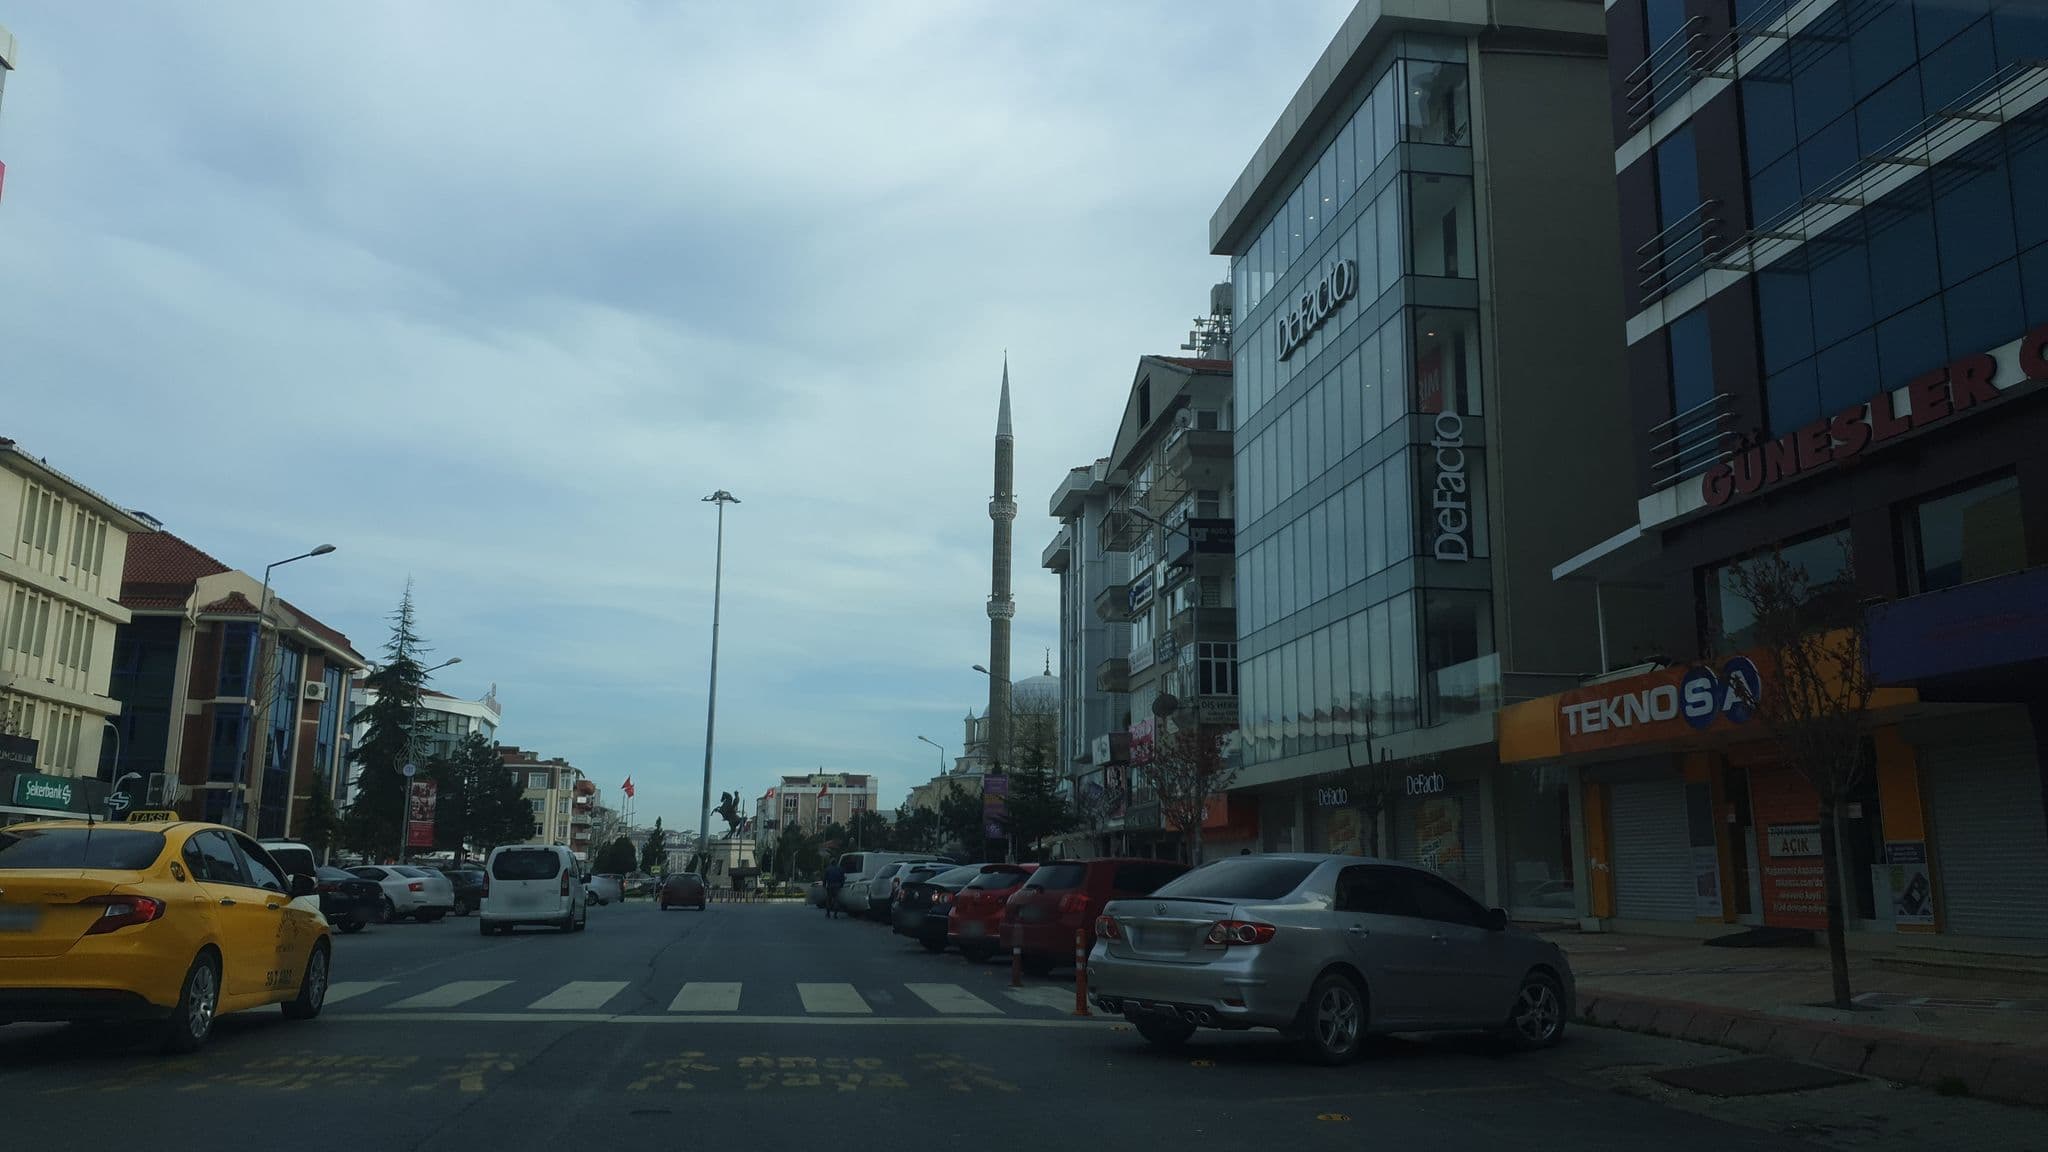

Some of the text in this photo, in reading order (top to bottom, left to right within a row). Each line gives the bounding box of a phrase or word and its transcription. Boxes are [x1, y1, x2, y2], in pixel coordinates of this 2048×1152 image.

[1277, 258, 1356, 362] DeFacto
[1430, 410, 1469, 562] DeFacto
[1562, 669, 1758, 737] TEKNOSA
[26, 780, 63, 800] Şekerbank
[1318, 786, 1348, 806] DeFacto
[1407, 771, 1445, 796] DeFacto
[1781, 837, 1809, 855] AÇIK
